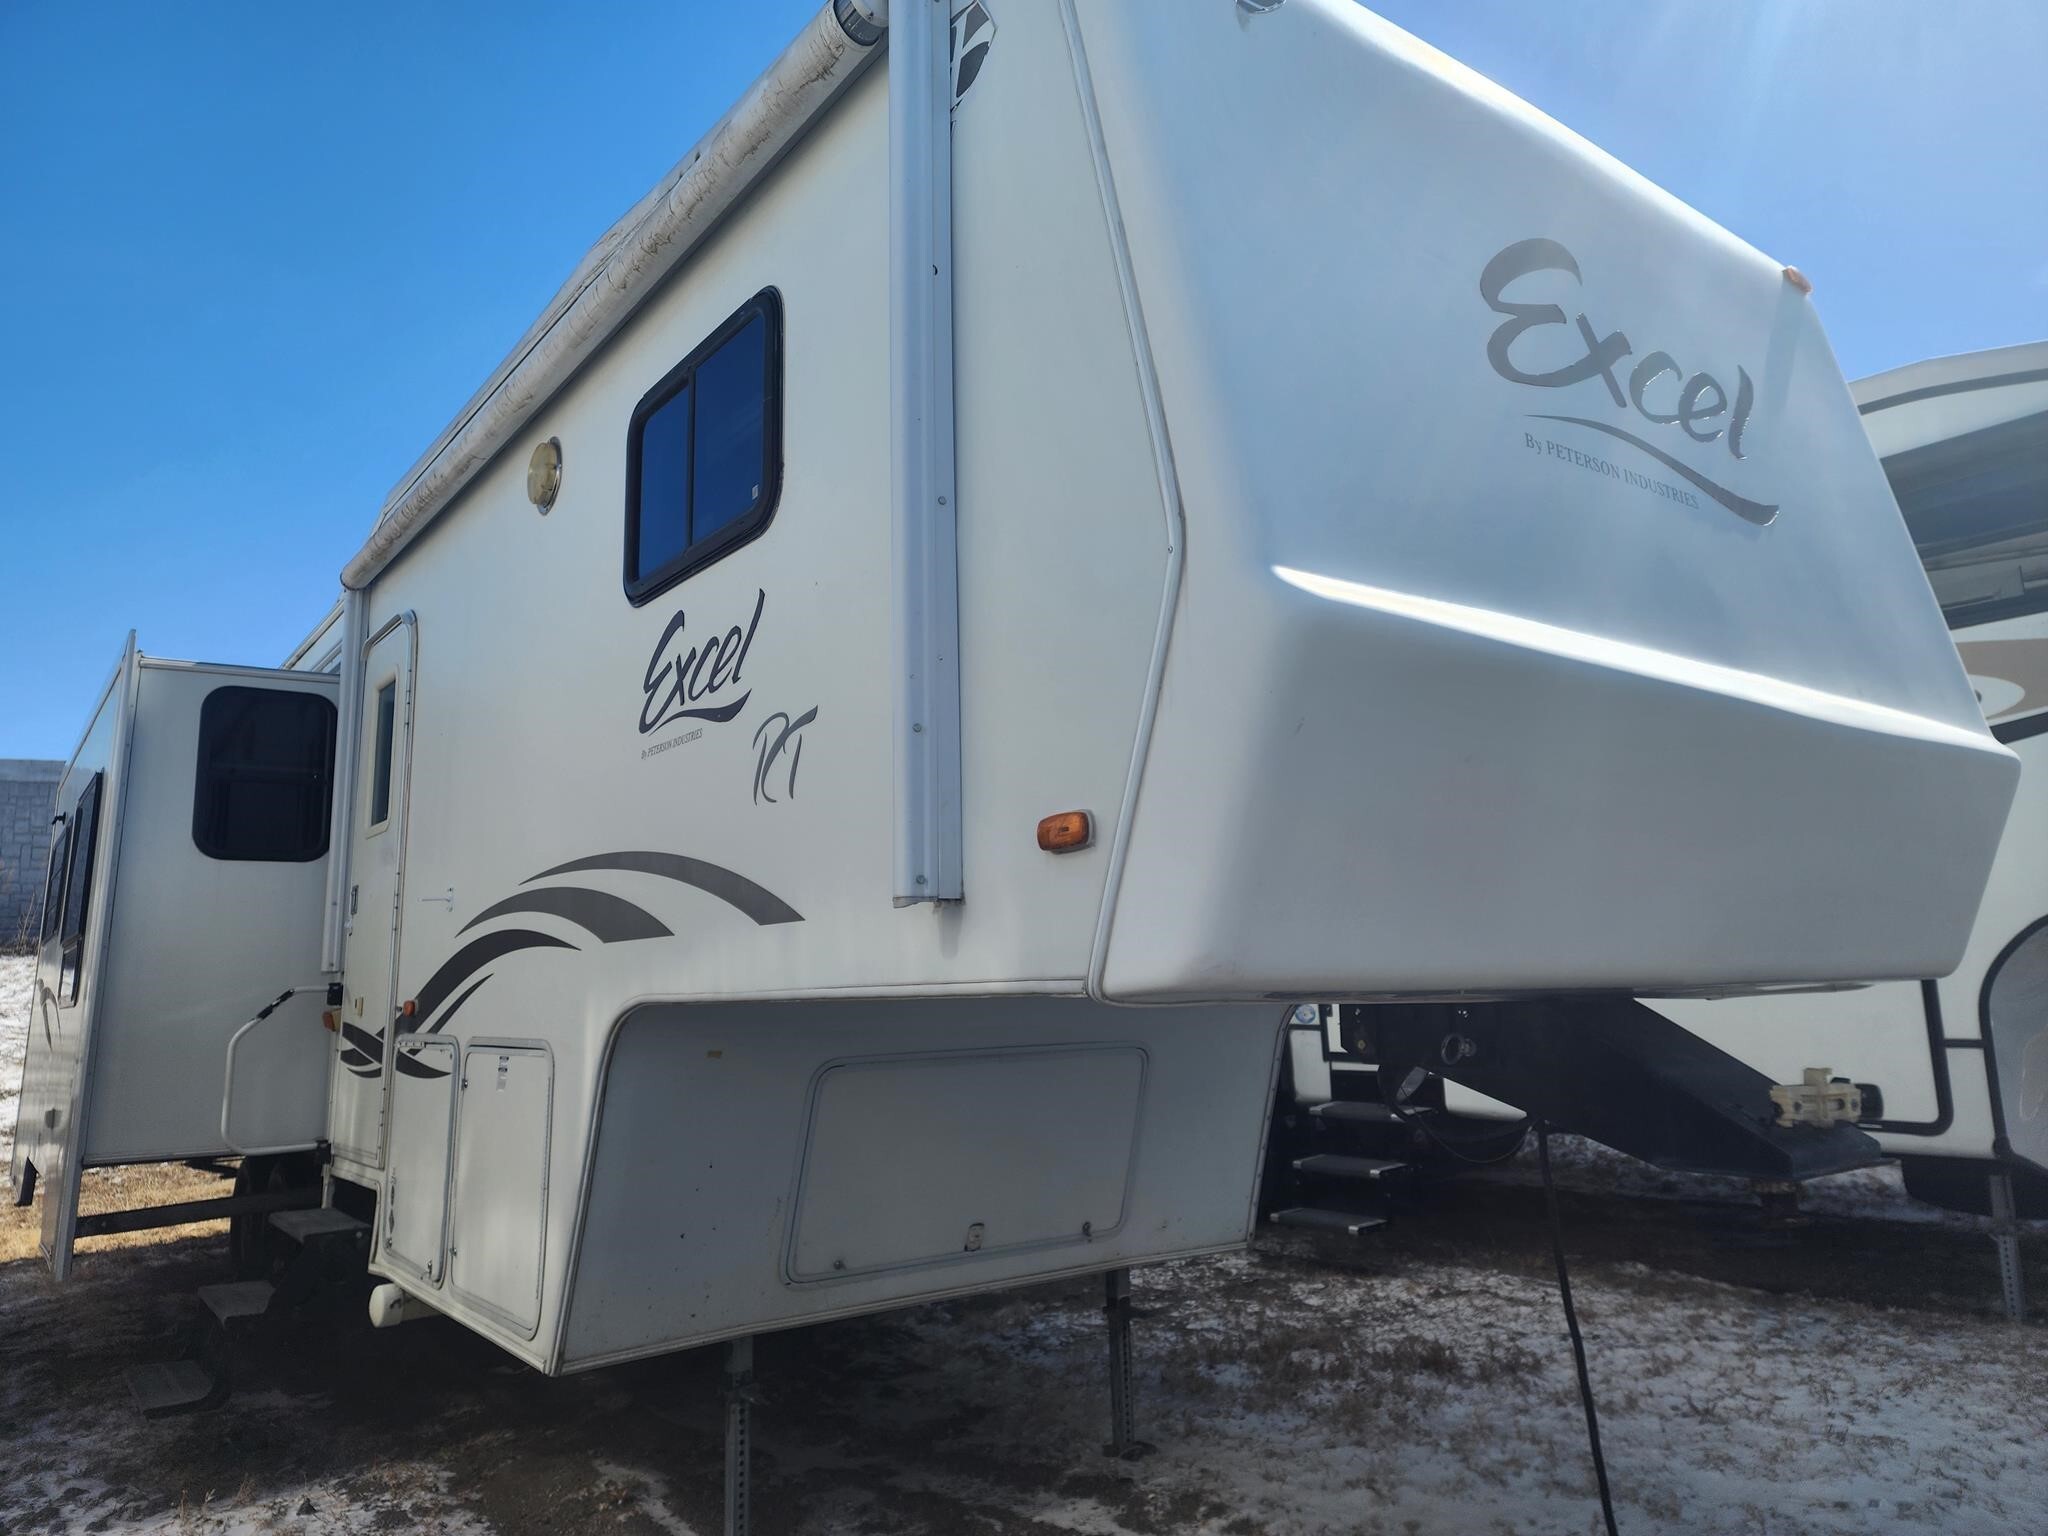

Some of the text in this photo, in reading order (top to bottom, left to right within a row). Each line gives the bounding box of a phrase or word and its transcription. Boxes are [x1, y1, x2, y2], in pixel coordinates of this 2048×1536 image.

[1480, 237, 1754, 460] Excel
[1524, 432, 1700, 509] By PETERSON INDUSTRIES
[638, 587, 766, 734] Excel
